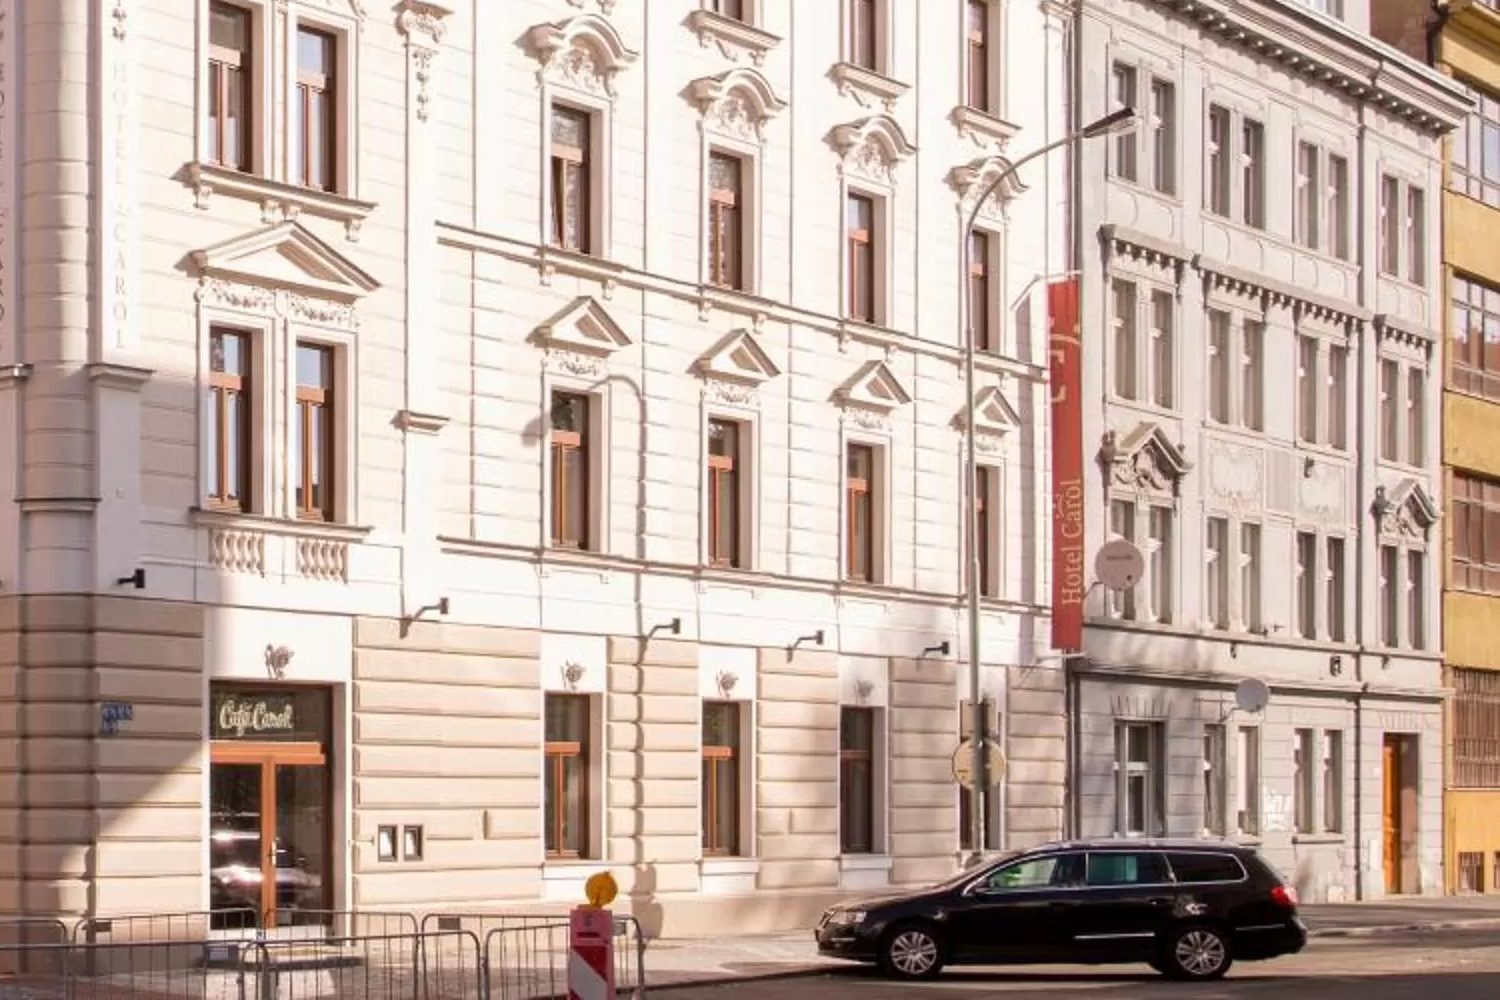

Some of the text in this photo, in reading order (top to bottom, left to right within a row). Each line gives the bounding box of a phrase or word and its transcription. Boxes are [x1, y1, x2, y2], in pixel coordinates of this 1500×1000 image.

[112, 60, 127, 349] HOTEL CAROL
[1060, 479, 1083, 605] Hotel Carol
